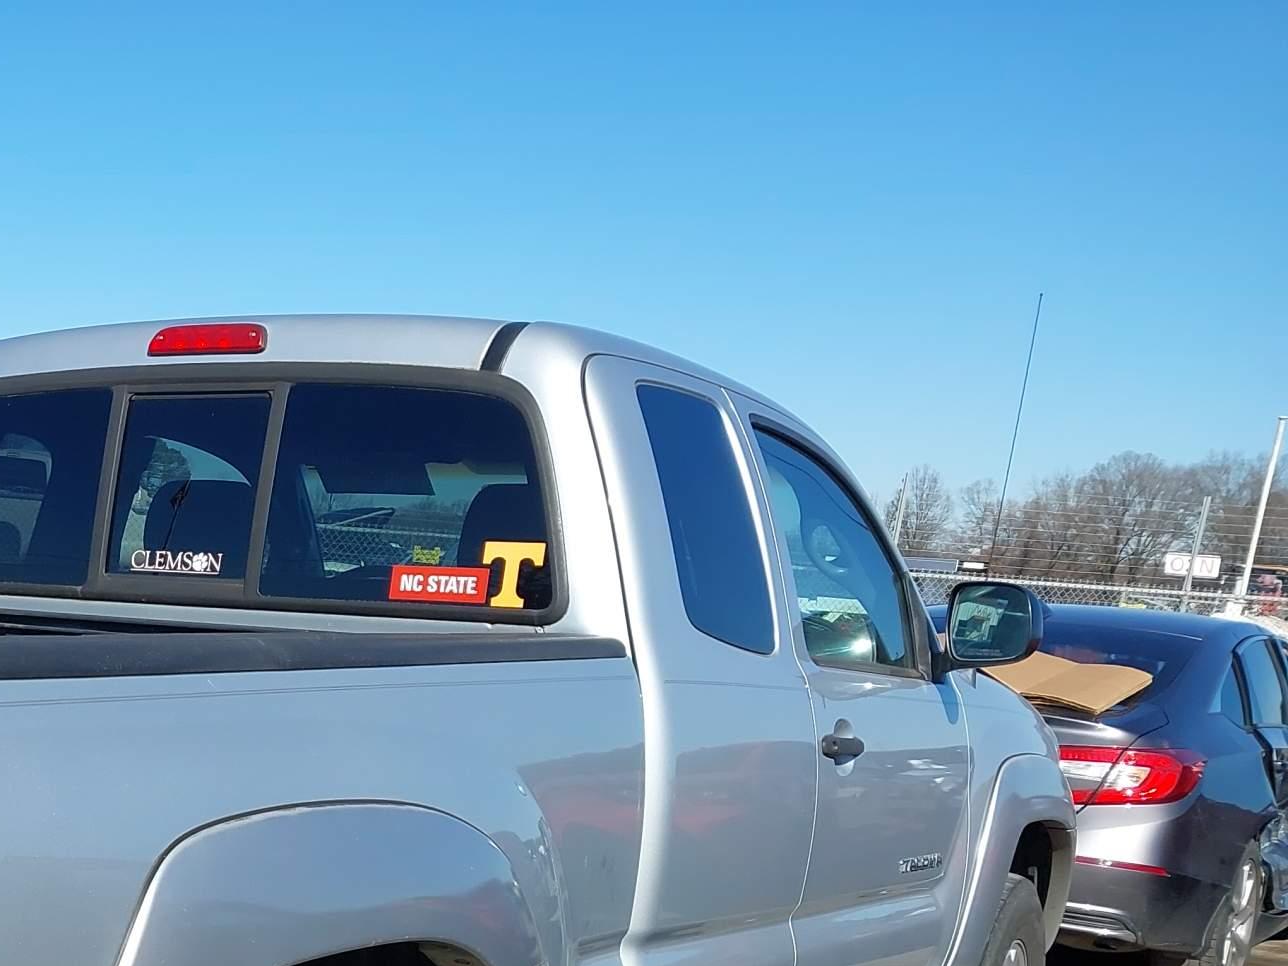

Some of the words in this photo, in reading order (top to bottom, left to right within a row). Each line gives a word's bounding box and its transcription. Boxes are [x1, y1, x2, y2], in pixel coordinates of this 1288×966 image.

[400, 574, 424, 592] NC
[427, 576, 478, 595] STATE
[483, 541, 546, 608] T
